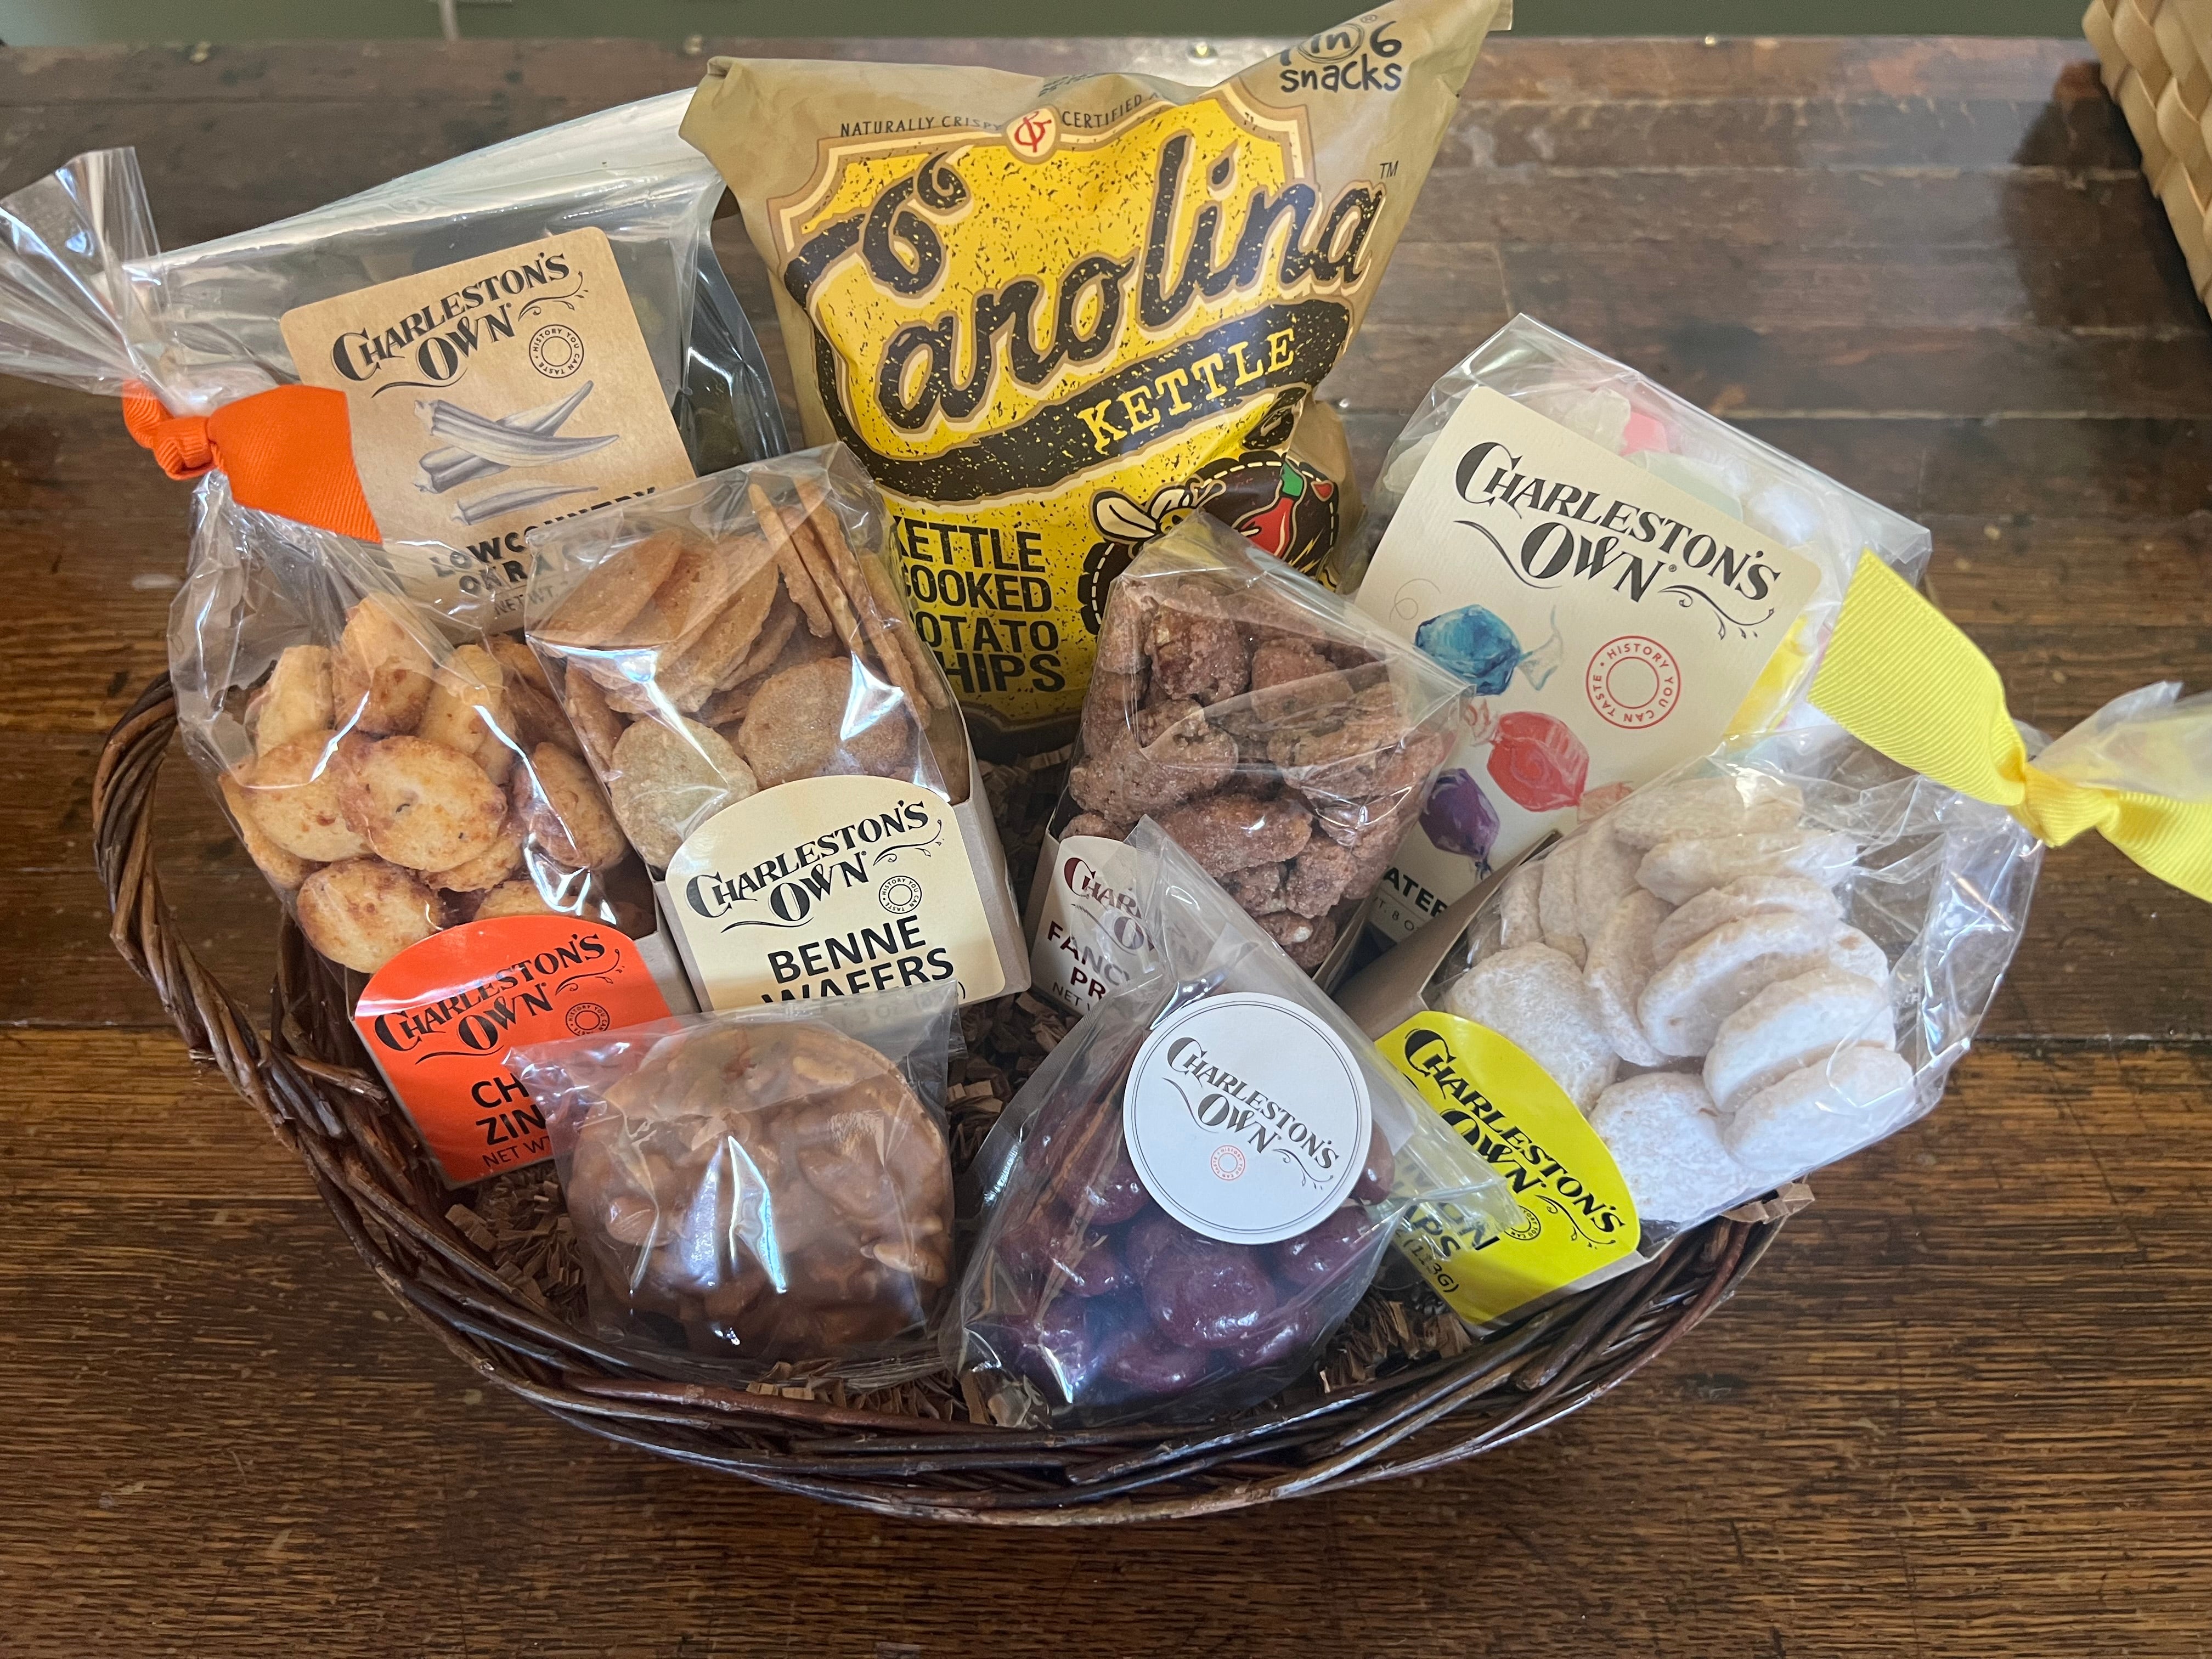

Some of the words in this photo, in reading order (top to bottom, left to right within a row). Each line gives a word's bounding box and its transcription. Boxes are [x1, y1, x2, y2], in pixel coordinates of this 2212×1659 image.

[1370, 20, 1402, 57] 6
[1279, 53, 1402, 93] snacks
[840, 116, 934, 137] NATURALLY
[941, 116, 1002, 131] CRISPY
[1062, 94, 1142, 128] CERTIFIED
[783, 133, 1386, 429] Carolina
[330, 252, 570, 381] CHARLESTON'S
[417, 306, 517, 381] OWN
[532, 328, 562, 352] HISTORY
[566, 331, 580, 348] YOU
[539, 362, 566, 375] TASTE
[567, 353, 580, 370] CAN
[1076, 328, 1295, 455] KETTLE
[1454, 442, 1781, 600] CHARLESTON'S
[1520, 522, 1666, 603] OWN
[902, 562, 1052, 612] OOKED
[910, 610, 1058, 653] OTATO
[932, 651, 1065, 693] HIPS
[1606, 643, 1669, 668] HISTORY
[1593, 674, 1616, 717] TASTE
[1658, 676, 1674, 708] YOU
[1623, 710, 1655, 723] CAN
[686, 800, 929, 918] CHARLESTON'S
[770, 852, 868, 922] OWN
[881, 878, 906, 895] HISTORY
[885, 902, 905, 912] TASTE
[908, 881, 919, 893] YOU
[909, 895, 919, 907] CAN
[768, 915, 926, 984] BENNE
[374, 934, 605, 1052] CHARLESTON'S
[1052, 982, 1082, 1006] NET
[457, 985, 553, 1050] OWN
[1167, 1037, 1340, 1169] CHARLESTON'S
[1198, 1093, 1280, 1154] OWN
[1404, 1029, 1625, 1233] CHARLESTON'S
[482, 1146, 519, 1167] NET
